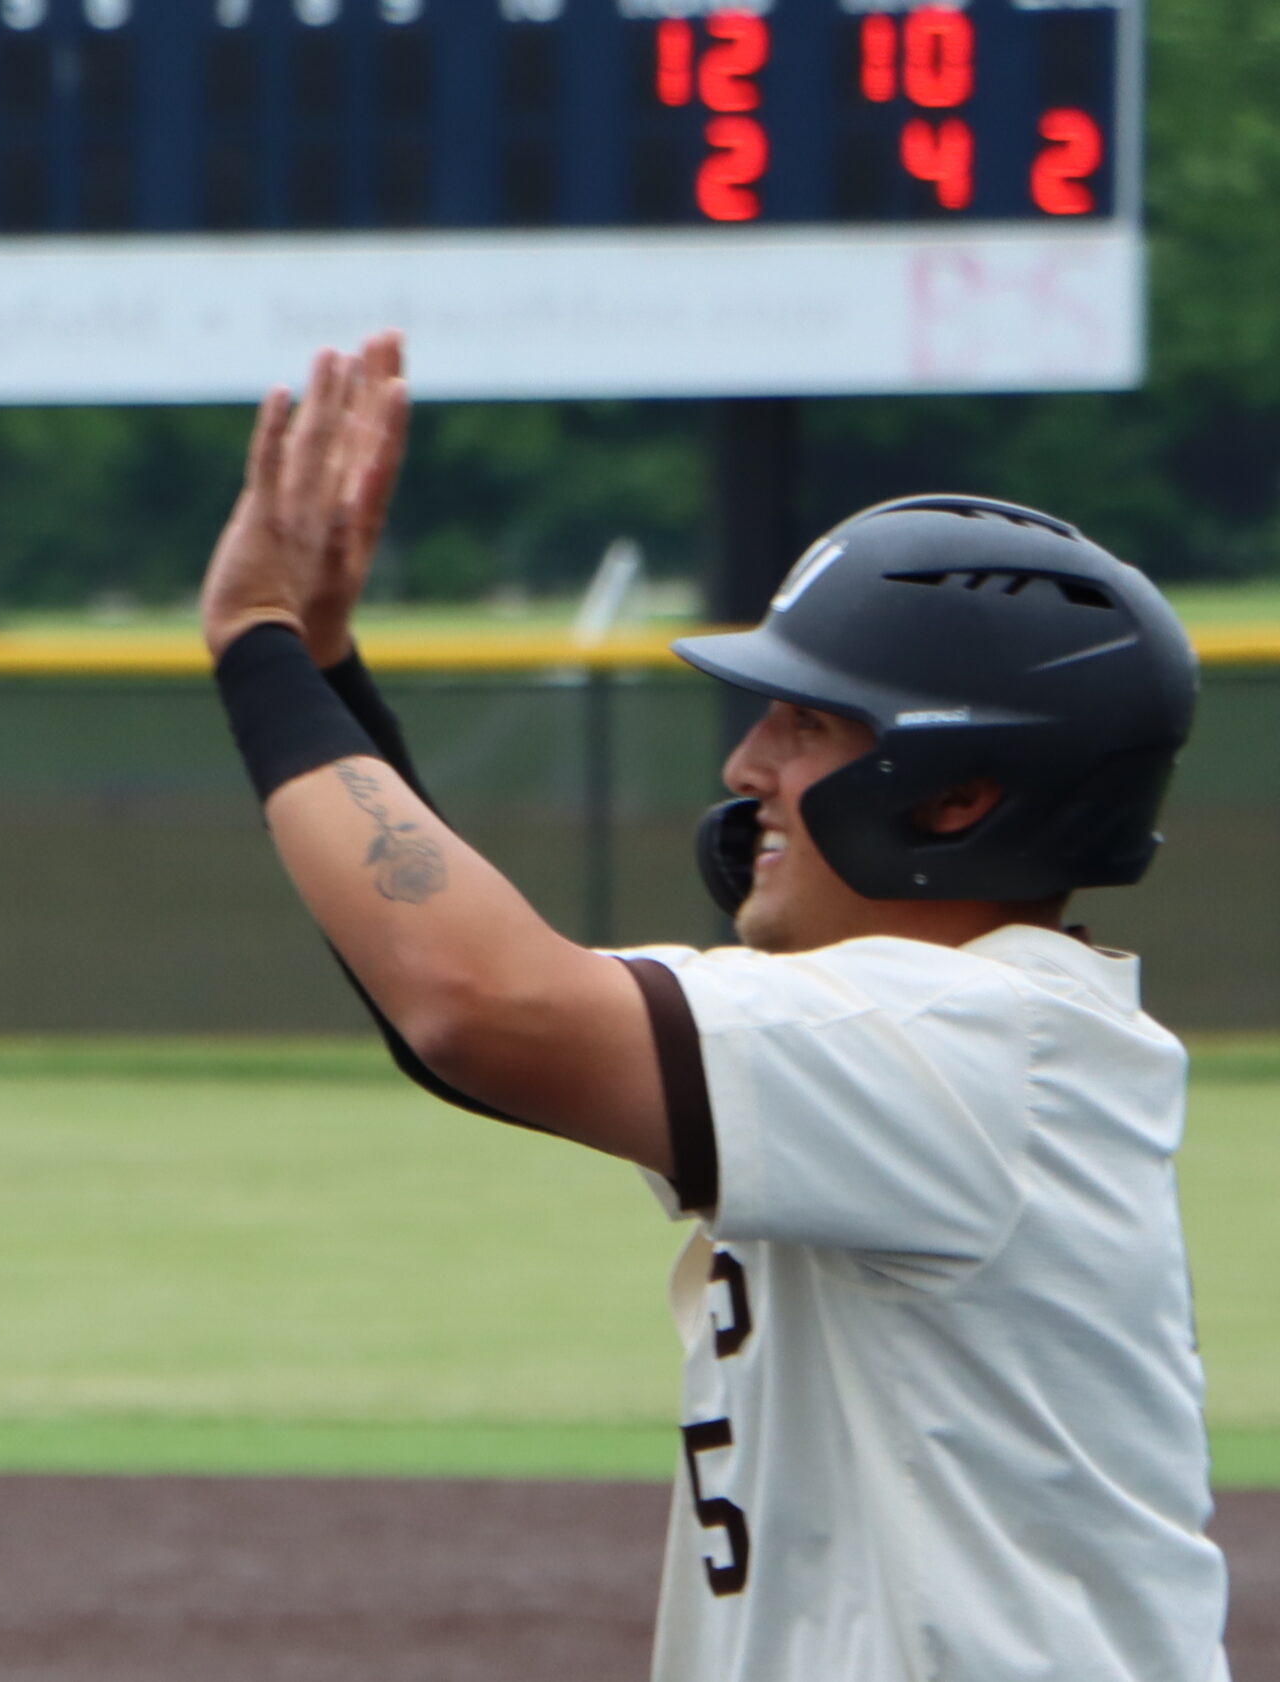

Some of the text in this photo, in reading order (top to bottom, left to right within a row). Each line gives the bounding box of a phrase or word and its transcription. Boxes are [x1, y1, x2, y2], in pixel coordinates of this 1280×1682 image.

[656, 10, 770, 112] 12
[860, 8, 974, 107] 10
[695, 115, 769, 221] 2
[901, 116, 974, 209] 4
[1030, 107, 1103, 215] 2
[680, 1417, 750, 1597] 5
